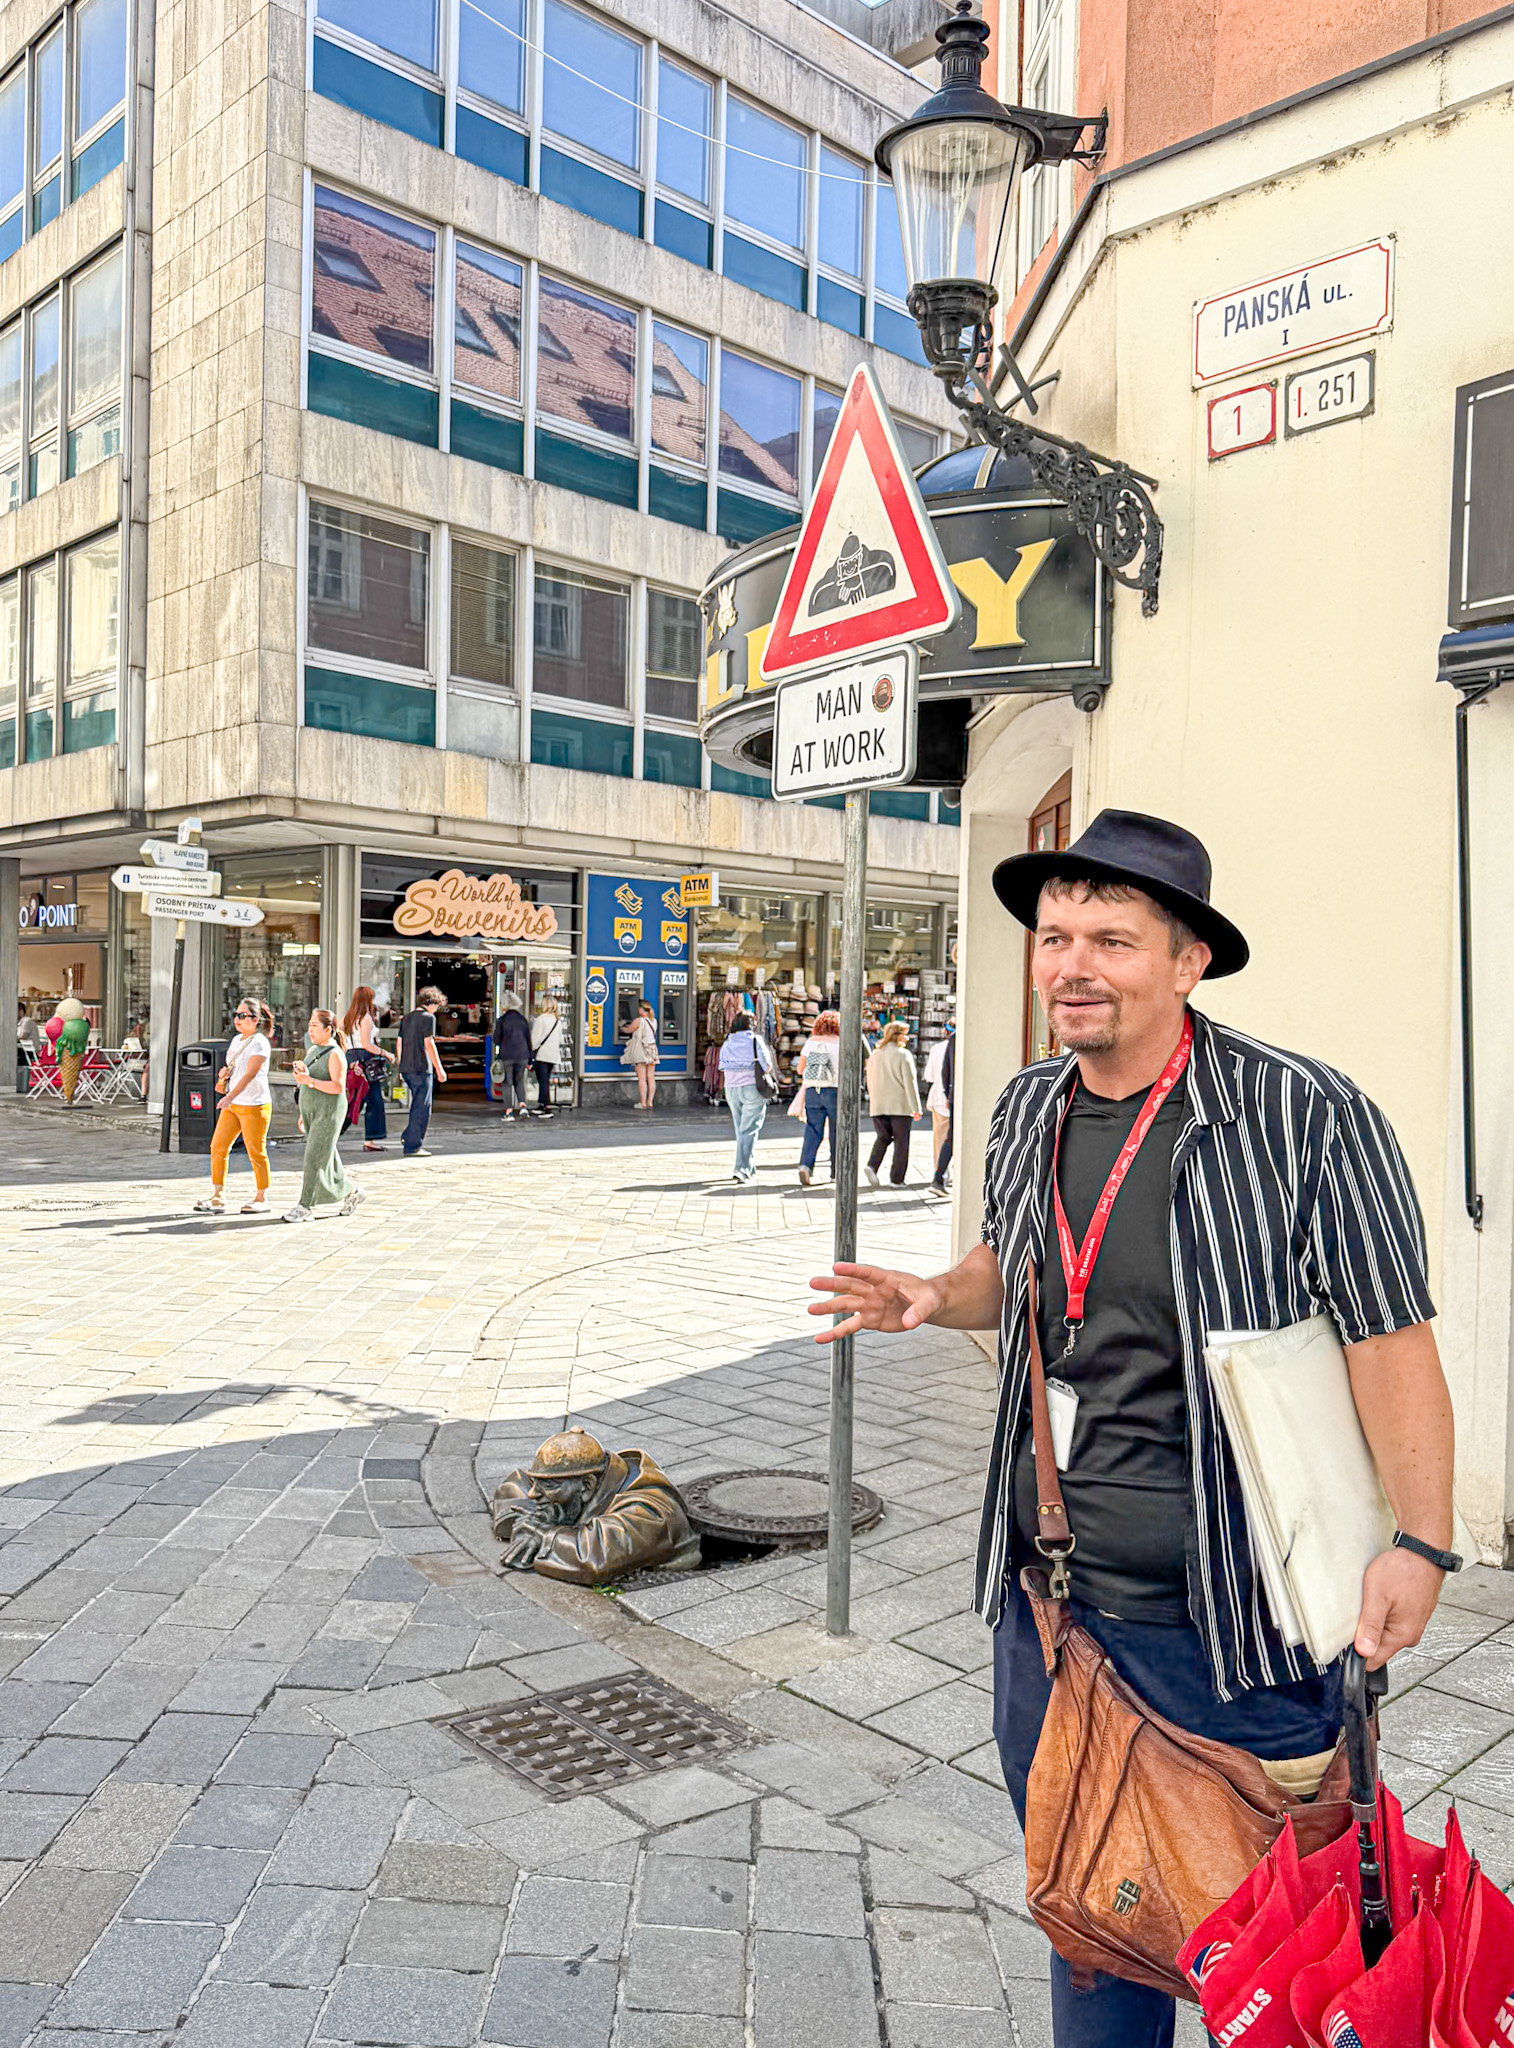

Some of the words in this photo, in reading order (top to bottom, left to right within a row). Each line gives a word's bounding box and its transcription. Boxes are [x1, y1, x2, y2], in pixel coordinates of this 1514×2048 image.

[1223, 273, 1311, 337] PANSKÁ
[1318, 370, 1355, 411] 251
[1232, 405, 1241, 436] 1
[816, 681, 862, 723] MAN
[790, 741, 816, 776] AT
[823, 727, 886, 769] WORK
[441, 876, 503, 903] World
[504, 889, 516, 910] of
[684, 878, 709, 891] ATM
[38, 903, 77, 928] POINT
[155, 906, 188, 916] PASSENGER
[156, 897, 187, 907] OSOBNÝ
[188, 900, 217, 911] PRÍSTAV
[398, 887, 552, 936] Souvenirs
[619, 922, 637, 930] ATM
[665, 925, 682, 933] ATM
[618, 972, 641, 981] ATM
[663, 974, 685, 983] ATM
